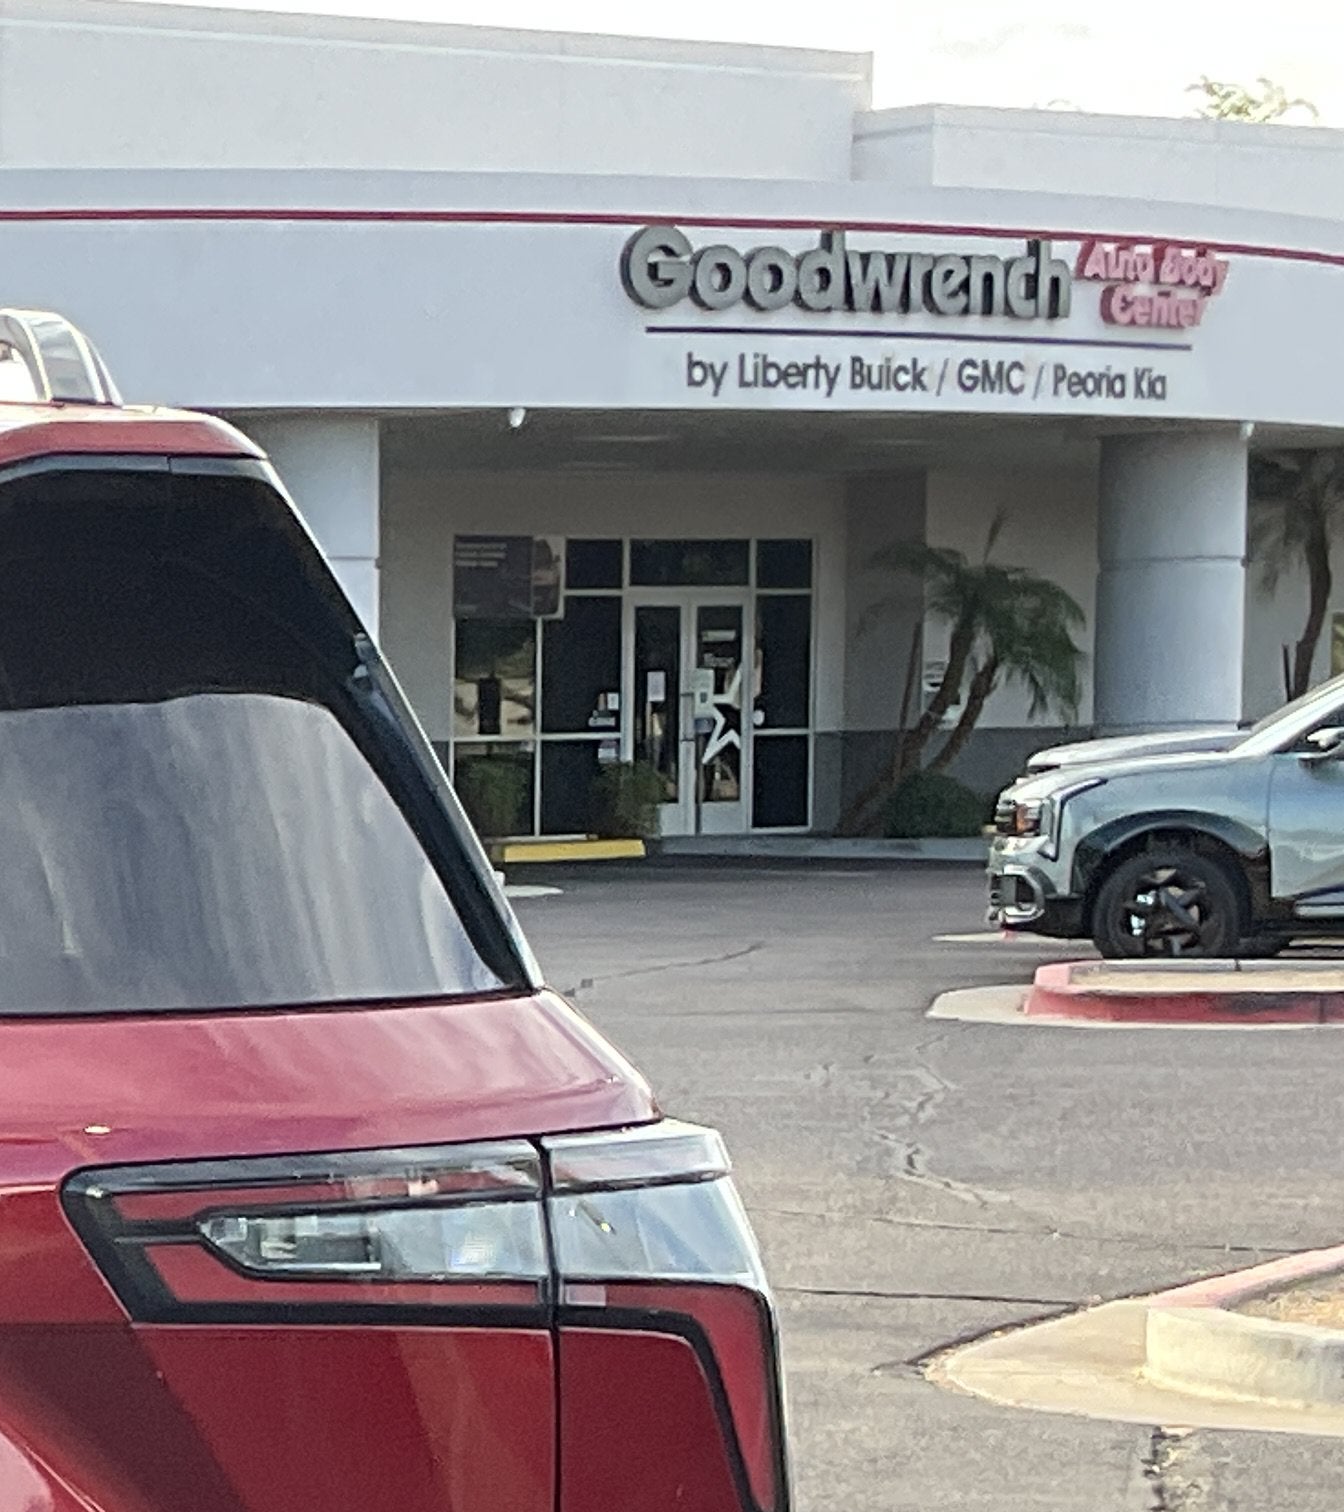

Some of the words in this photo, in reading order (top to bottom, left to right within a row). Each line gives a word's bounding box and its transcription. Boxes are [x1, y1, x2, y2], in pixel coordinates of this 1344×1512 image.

[620, 224, 1072, 321] Goodwrench
[1077, 240, 1155, 281] Auto
[1156, 243, 1229, 296] Body
[1101, 283, 1208, 329] Center
[687, 351, 729, 397] by
[738, 352, 841, 398] Liberty
[849, 355, 928, 392] Buick
[957, 358, 1025, 396] GMC
[1052, 363, 1126, 399] Peoria
[1133, 366, 1167, 401] Kia
